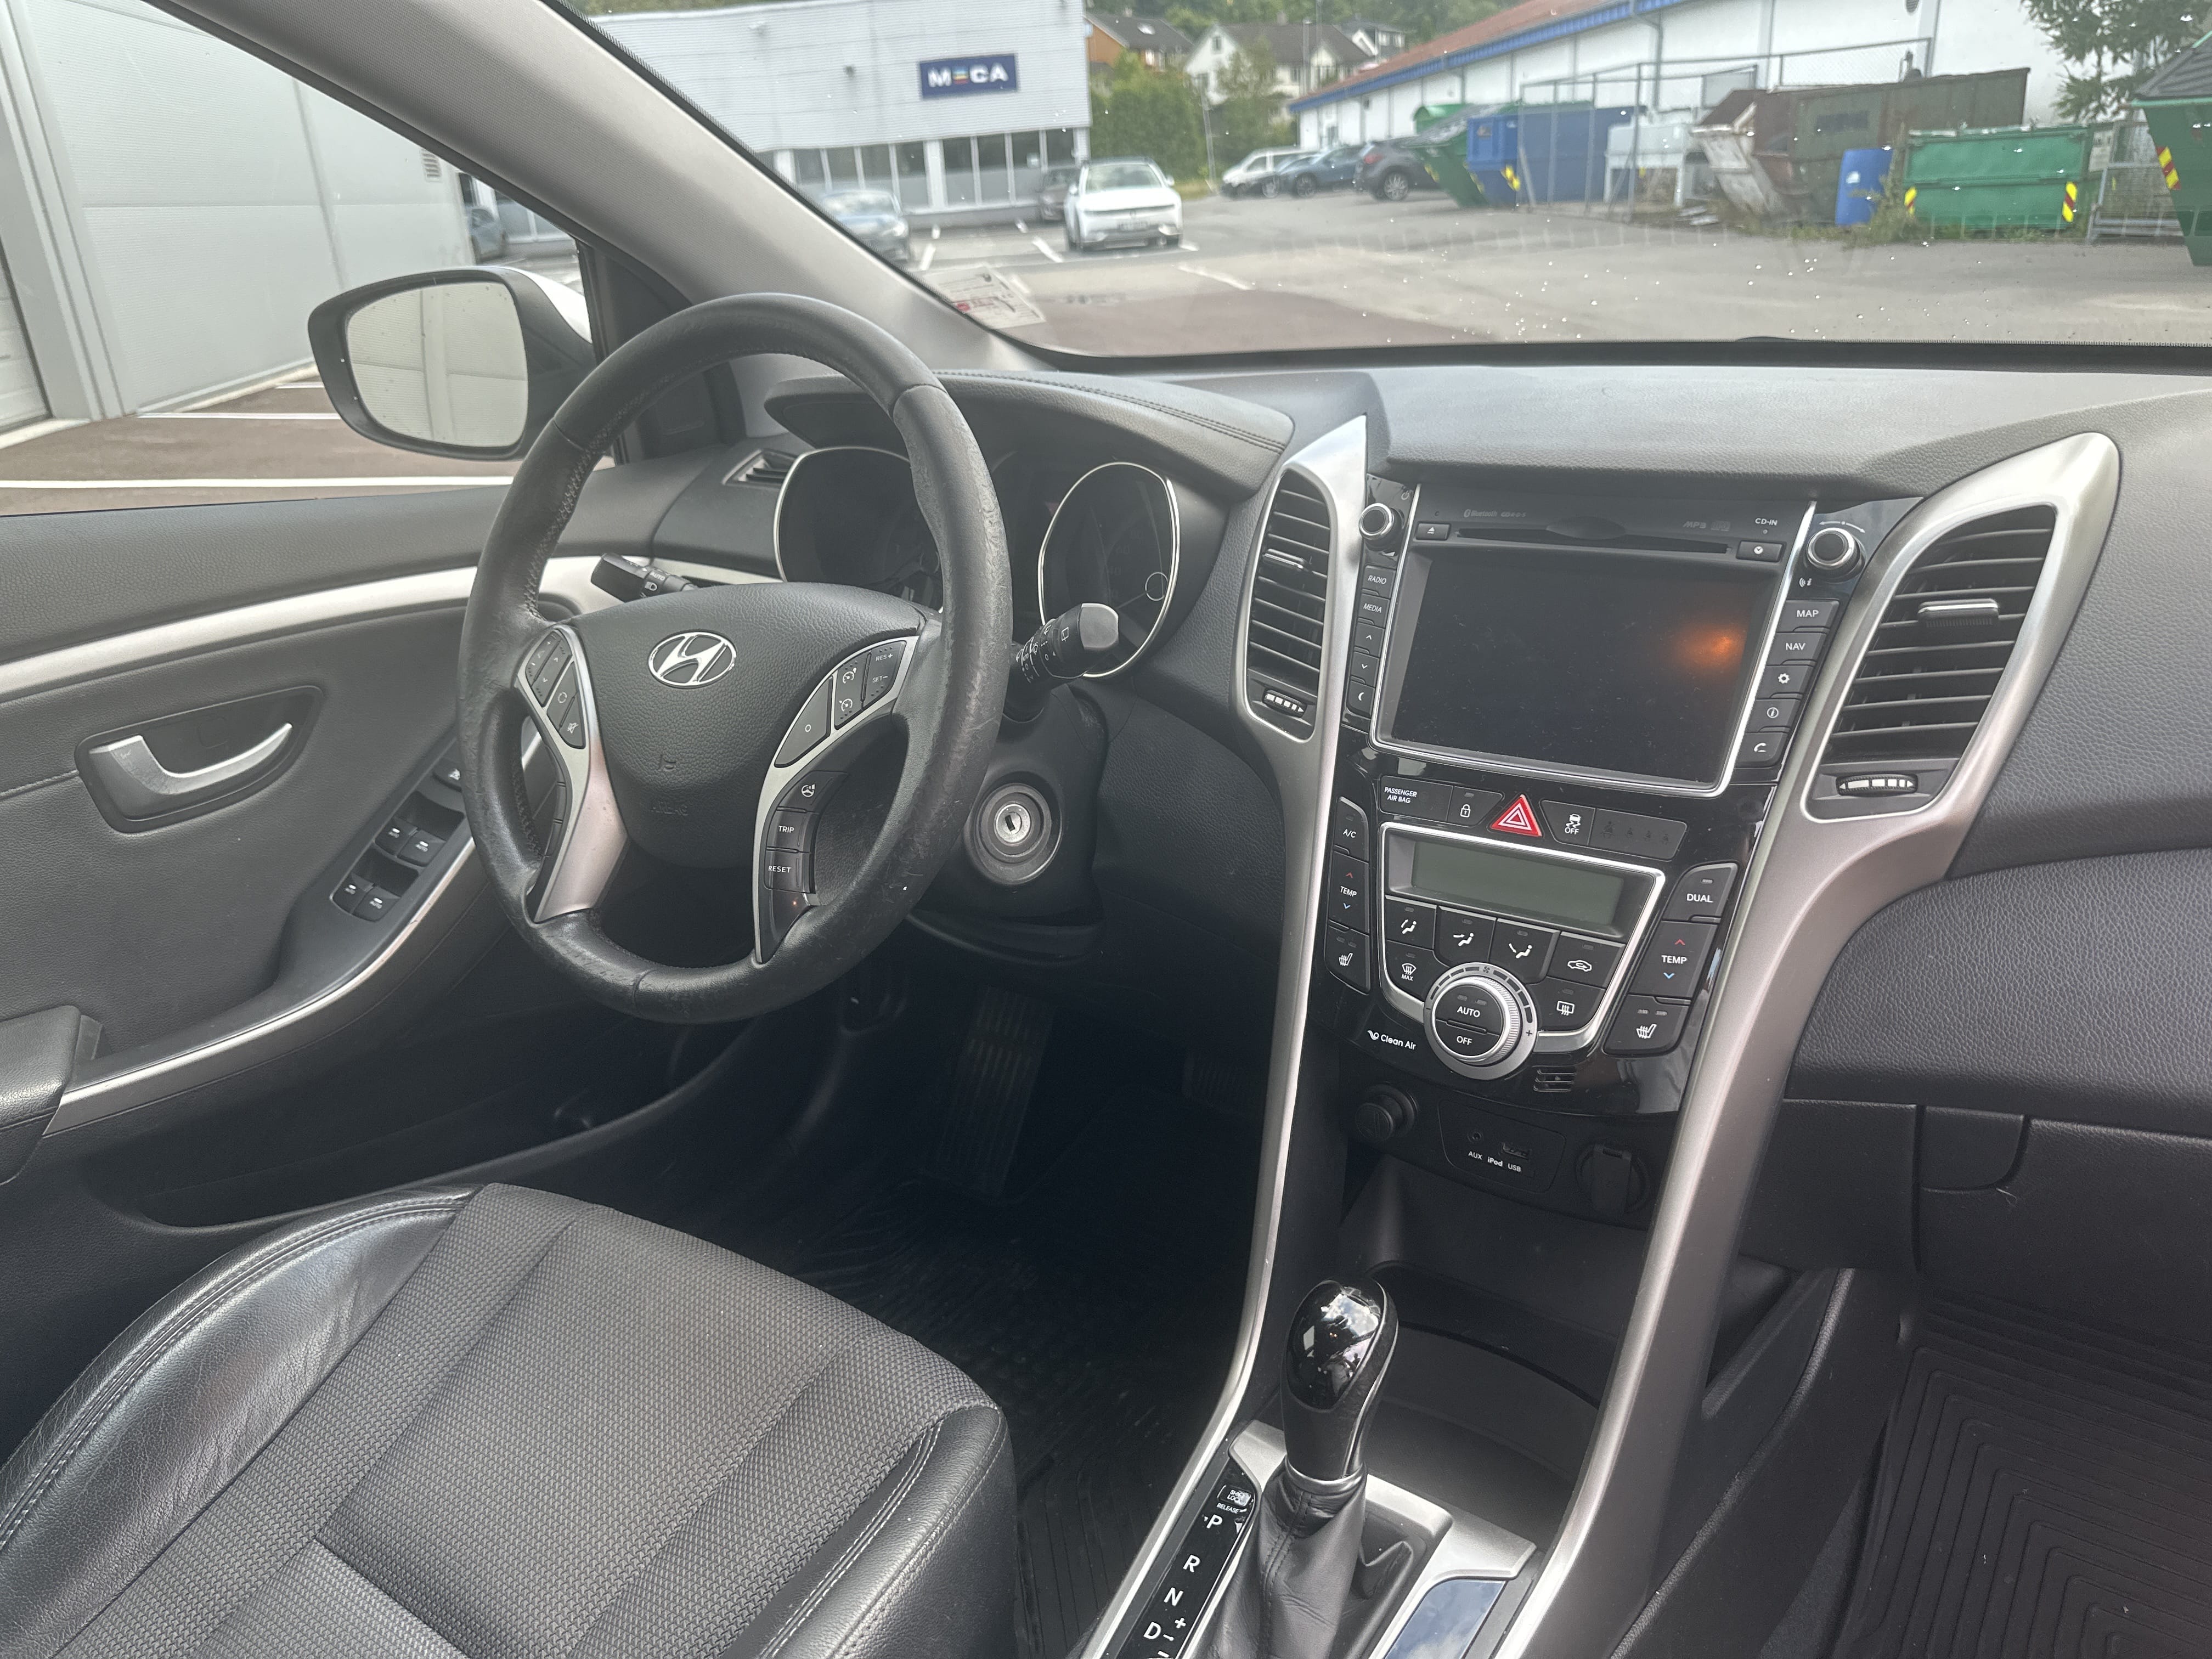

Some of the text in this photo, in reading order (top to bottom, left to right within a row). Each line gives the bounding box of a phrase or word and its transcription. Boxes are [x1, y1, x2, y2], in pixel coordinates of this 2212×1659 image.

[928, 63, 1009, 87] MECA
[1755, 517, 1778, 526] CD-IN
[1368, 575, 1387, 584] RADIO
[1363, 603, 1382, 613] MEDIA
[1384, 787, 1418, 797] PASSENGER
[1342, 828, 1357, 838] A/C
[768, 865, 792, 873] RESET
[1340, 885, 1357, 897] TEMP
[1686, 893, 1713, 903] DUAL
[1661, 955, 1688, 964] TEMP
[1457, 1006, 1481, 1018] AUTO
[1380, 1034, 1416, 1050] Clean Air
[1456, 1035, 1472, 1046] OFF
[1468, 1151, 1521, 1172] AUX iPod USB
[1216, 1503, 1239, 1514] RELEASE
[1206, 1514, 1223, 1529] P
[1183, 1554, 1200, 1573] R
[1164, 1587, 1184, 1606] N
[1143, 1621, 1161, 1640] D
